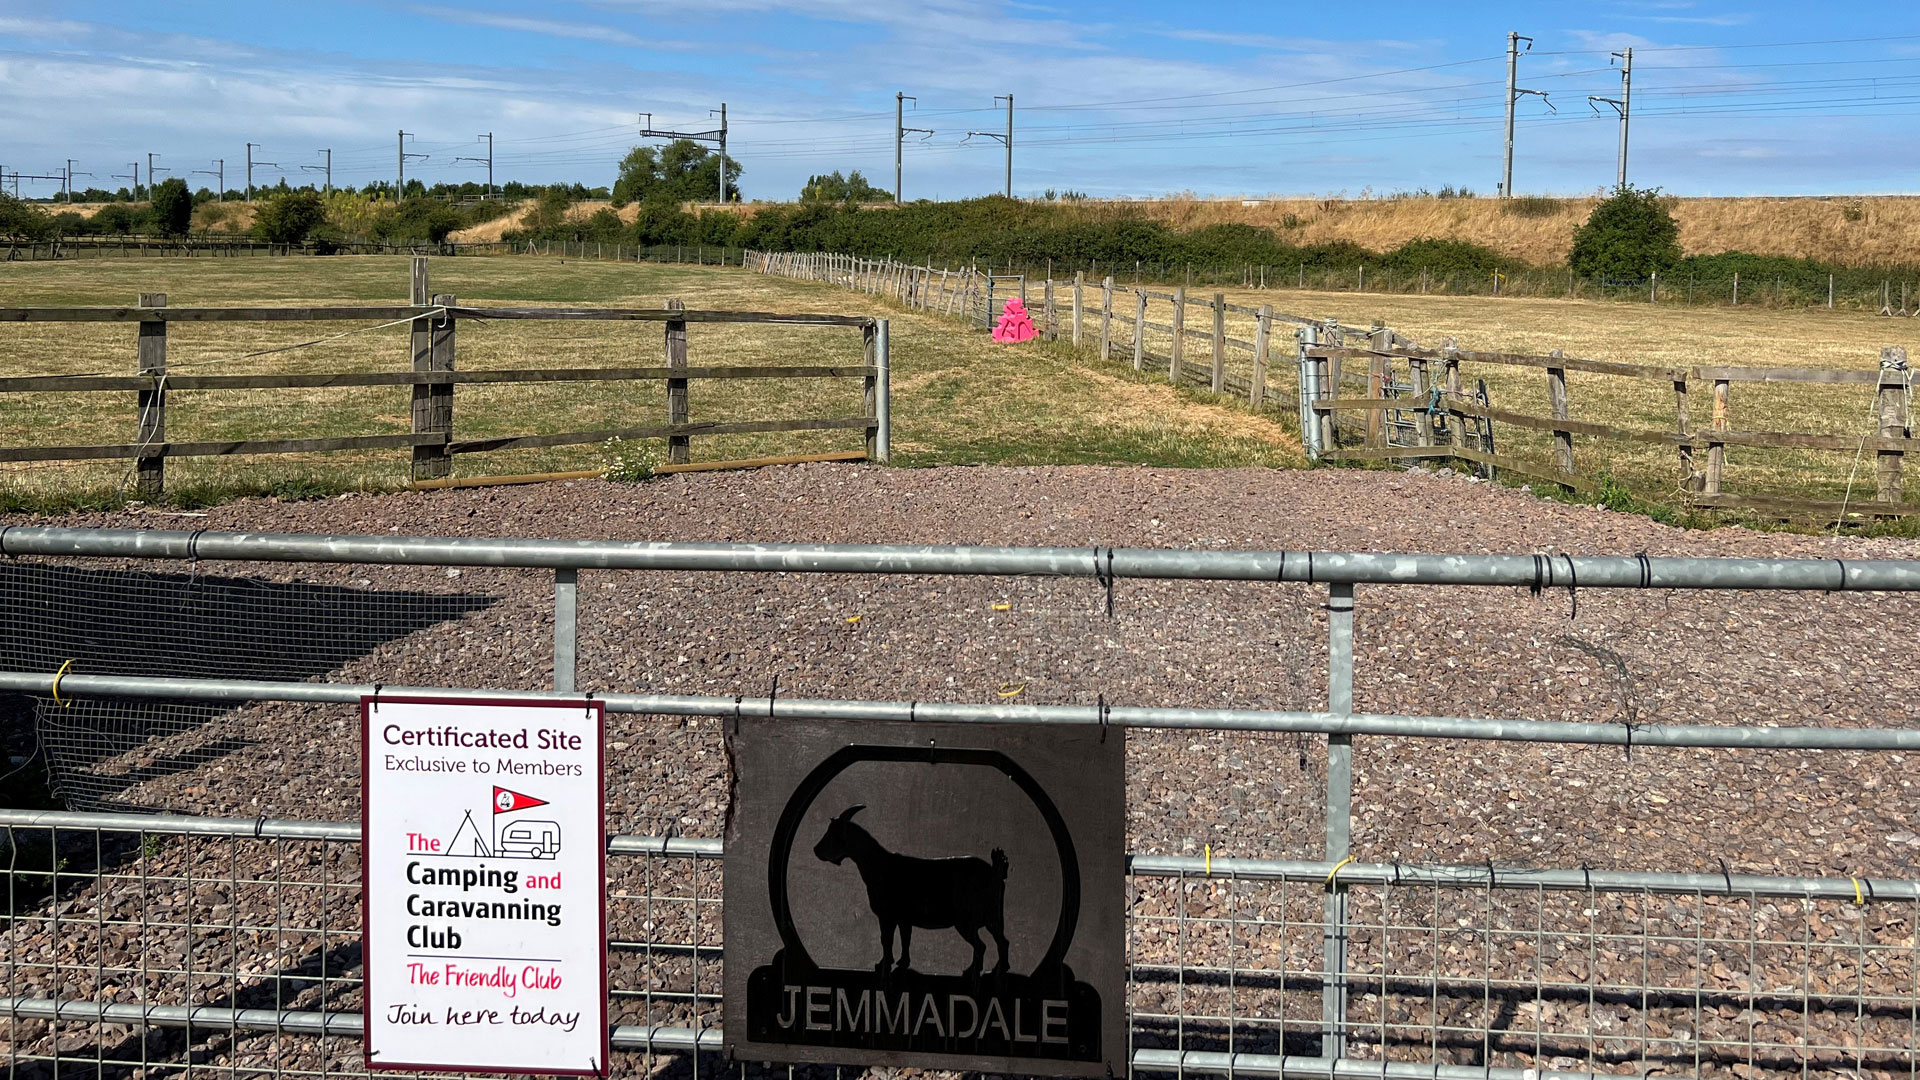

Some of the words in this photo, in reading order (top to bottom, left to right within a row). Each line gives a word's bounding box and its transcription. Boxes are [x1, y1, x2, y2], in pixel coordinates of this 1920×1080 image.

[383, 725, 528, 748] Certificated
[538, 729, 582, 750] Site
[385, 755, 466, 773] Exclusive
[473, 759, 491, 774] to
[496, 759, 582, 776] Members
[406, 833, 440, 851] The
[407, 862, 518, 893] Camping
[526, 872, 561, 889] and
[407, 894, 561, 926] Caravanning
[407, 925, 461, 949] Club
[407, 963, 439, 985] The
[446, 964, 516, 997] Friendly
[522, 968, 561, 989] Club
[387, 1004, 438, 1025] Join
[446, 1006, 503, 1026] here
[510, 1006, 580, 1032] today
[777, 985, 1069, 1044] JEMMADALE
